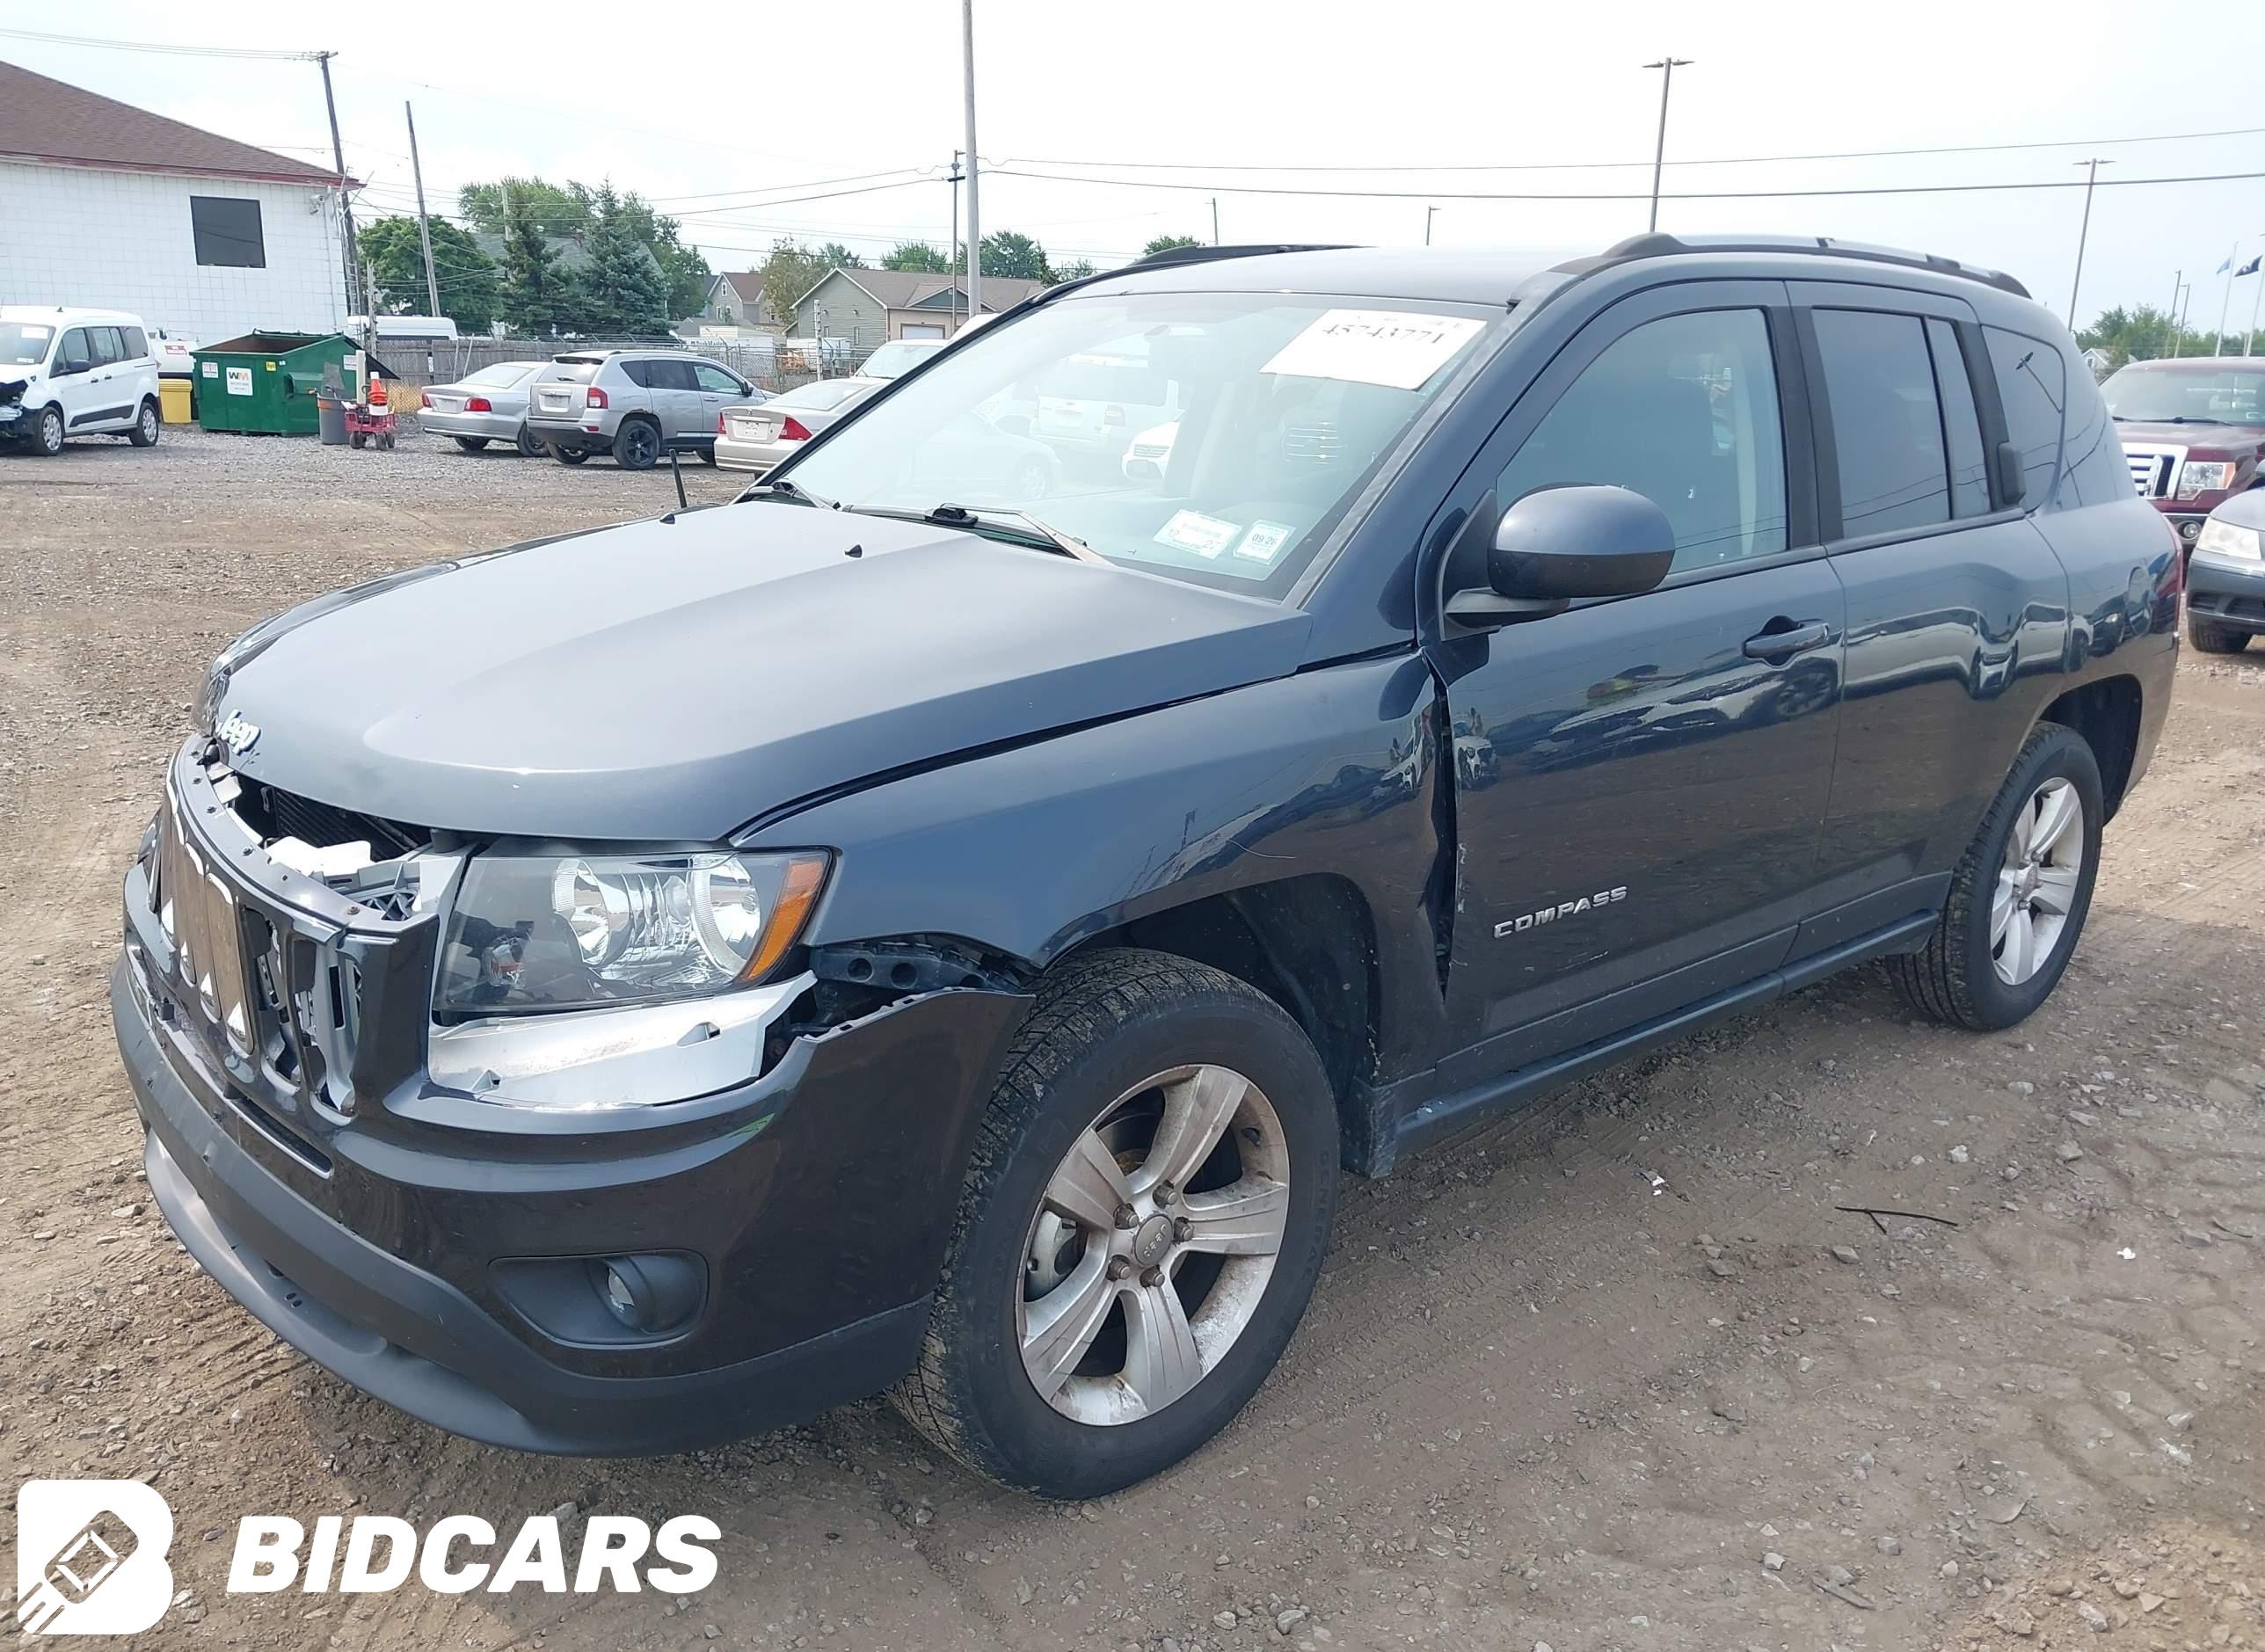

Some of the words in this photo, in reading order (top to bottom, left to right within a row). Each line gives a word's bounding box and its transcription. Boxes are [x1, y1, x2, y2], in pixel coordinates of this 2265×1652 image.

[229, 371, 249, 380] WM
[215, 709, 262, 755] Jeep
[1494, 885, 1628, 938] COMPASS
